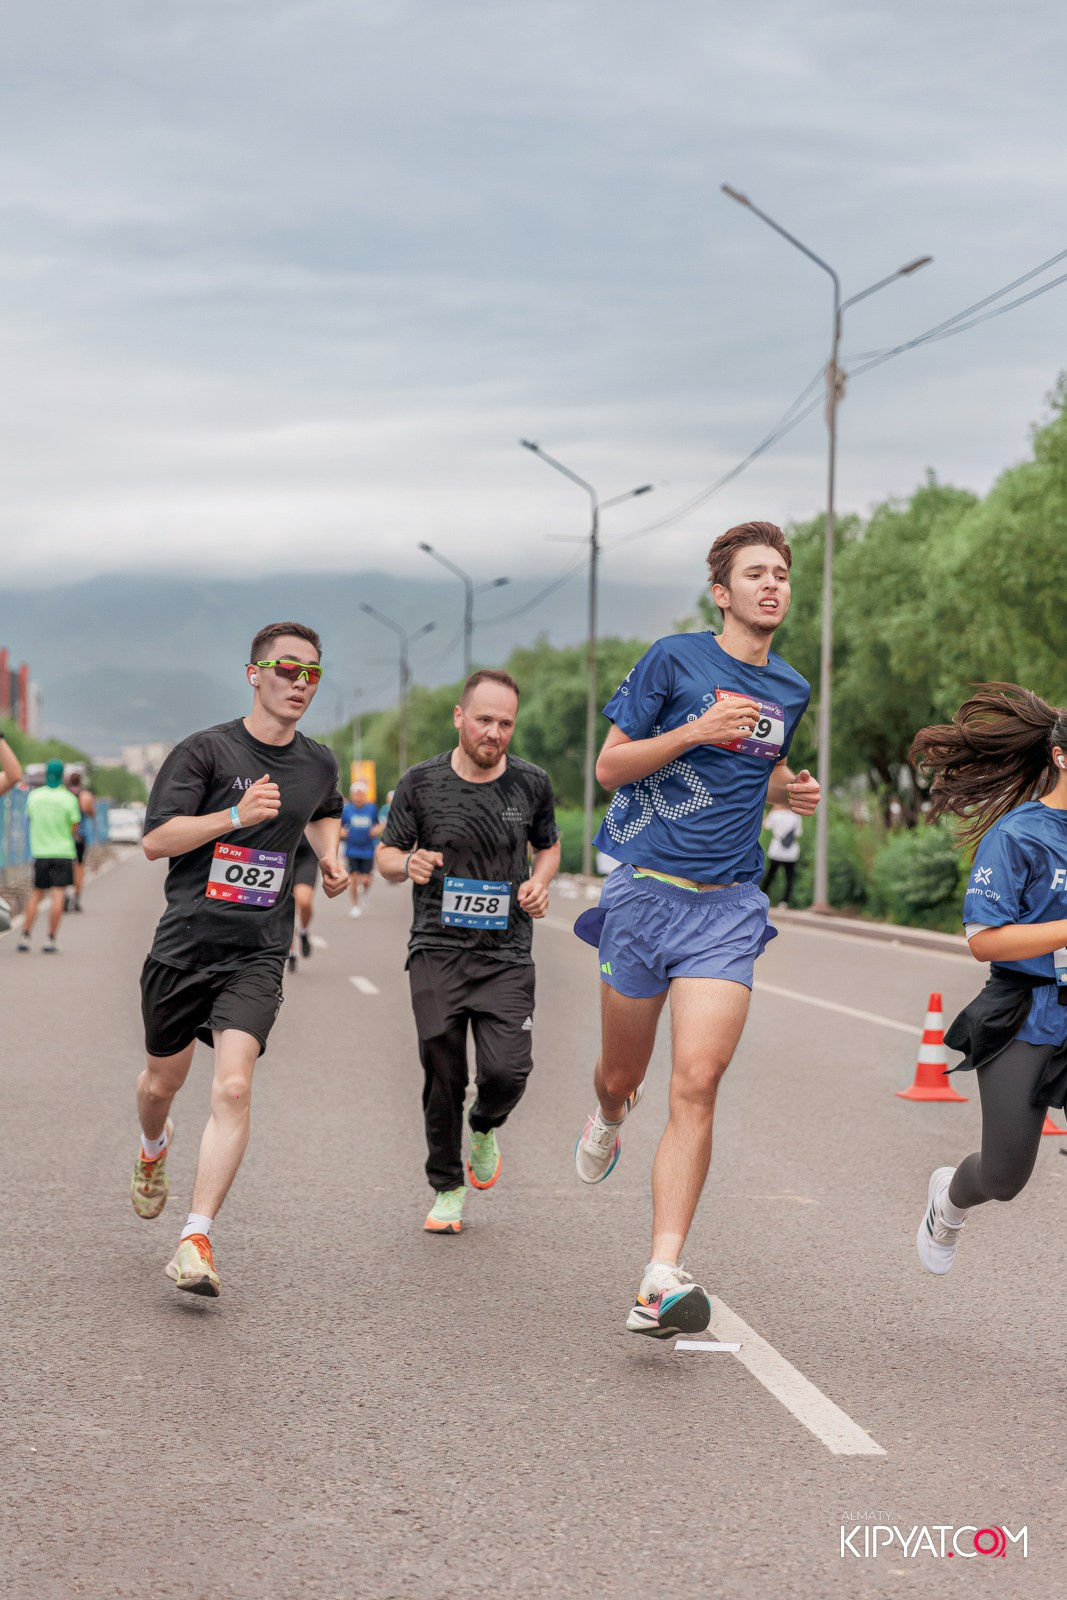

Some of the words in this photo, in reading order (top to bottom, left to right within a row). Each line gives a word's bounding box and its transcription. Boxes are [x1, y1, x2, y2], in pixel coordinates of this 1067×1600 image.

[218, 846, 229, 854] 10
[225, 864, 275, 889] 082
[984, 889, 1001, 901] City
[454, 895, 500, 914] 1158
